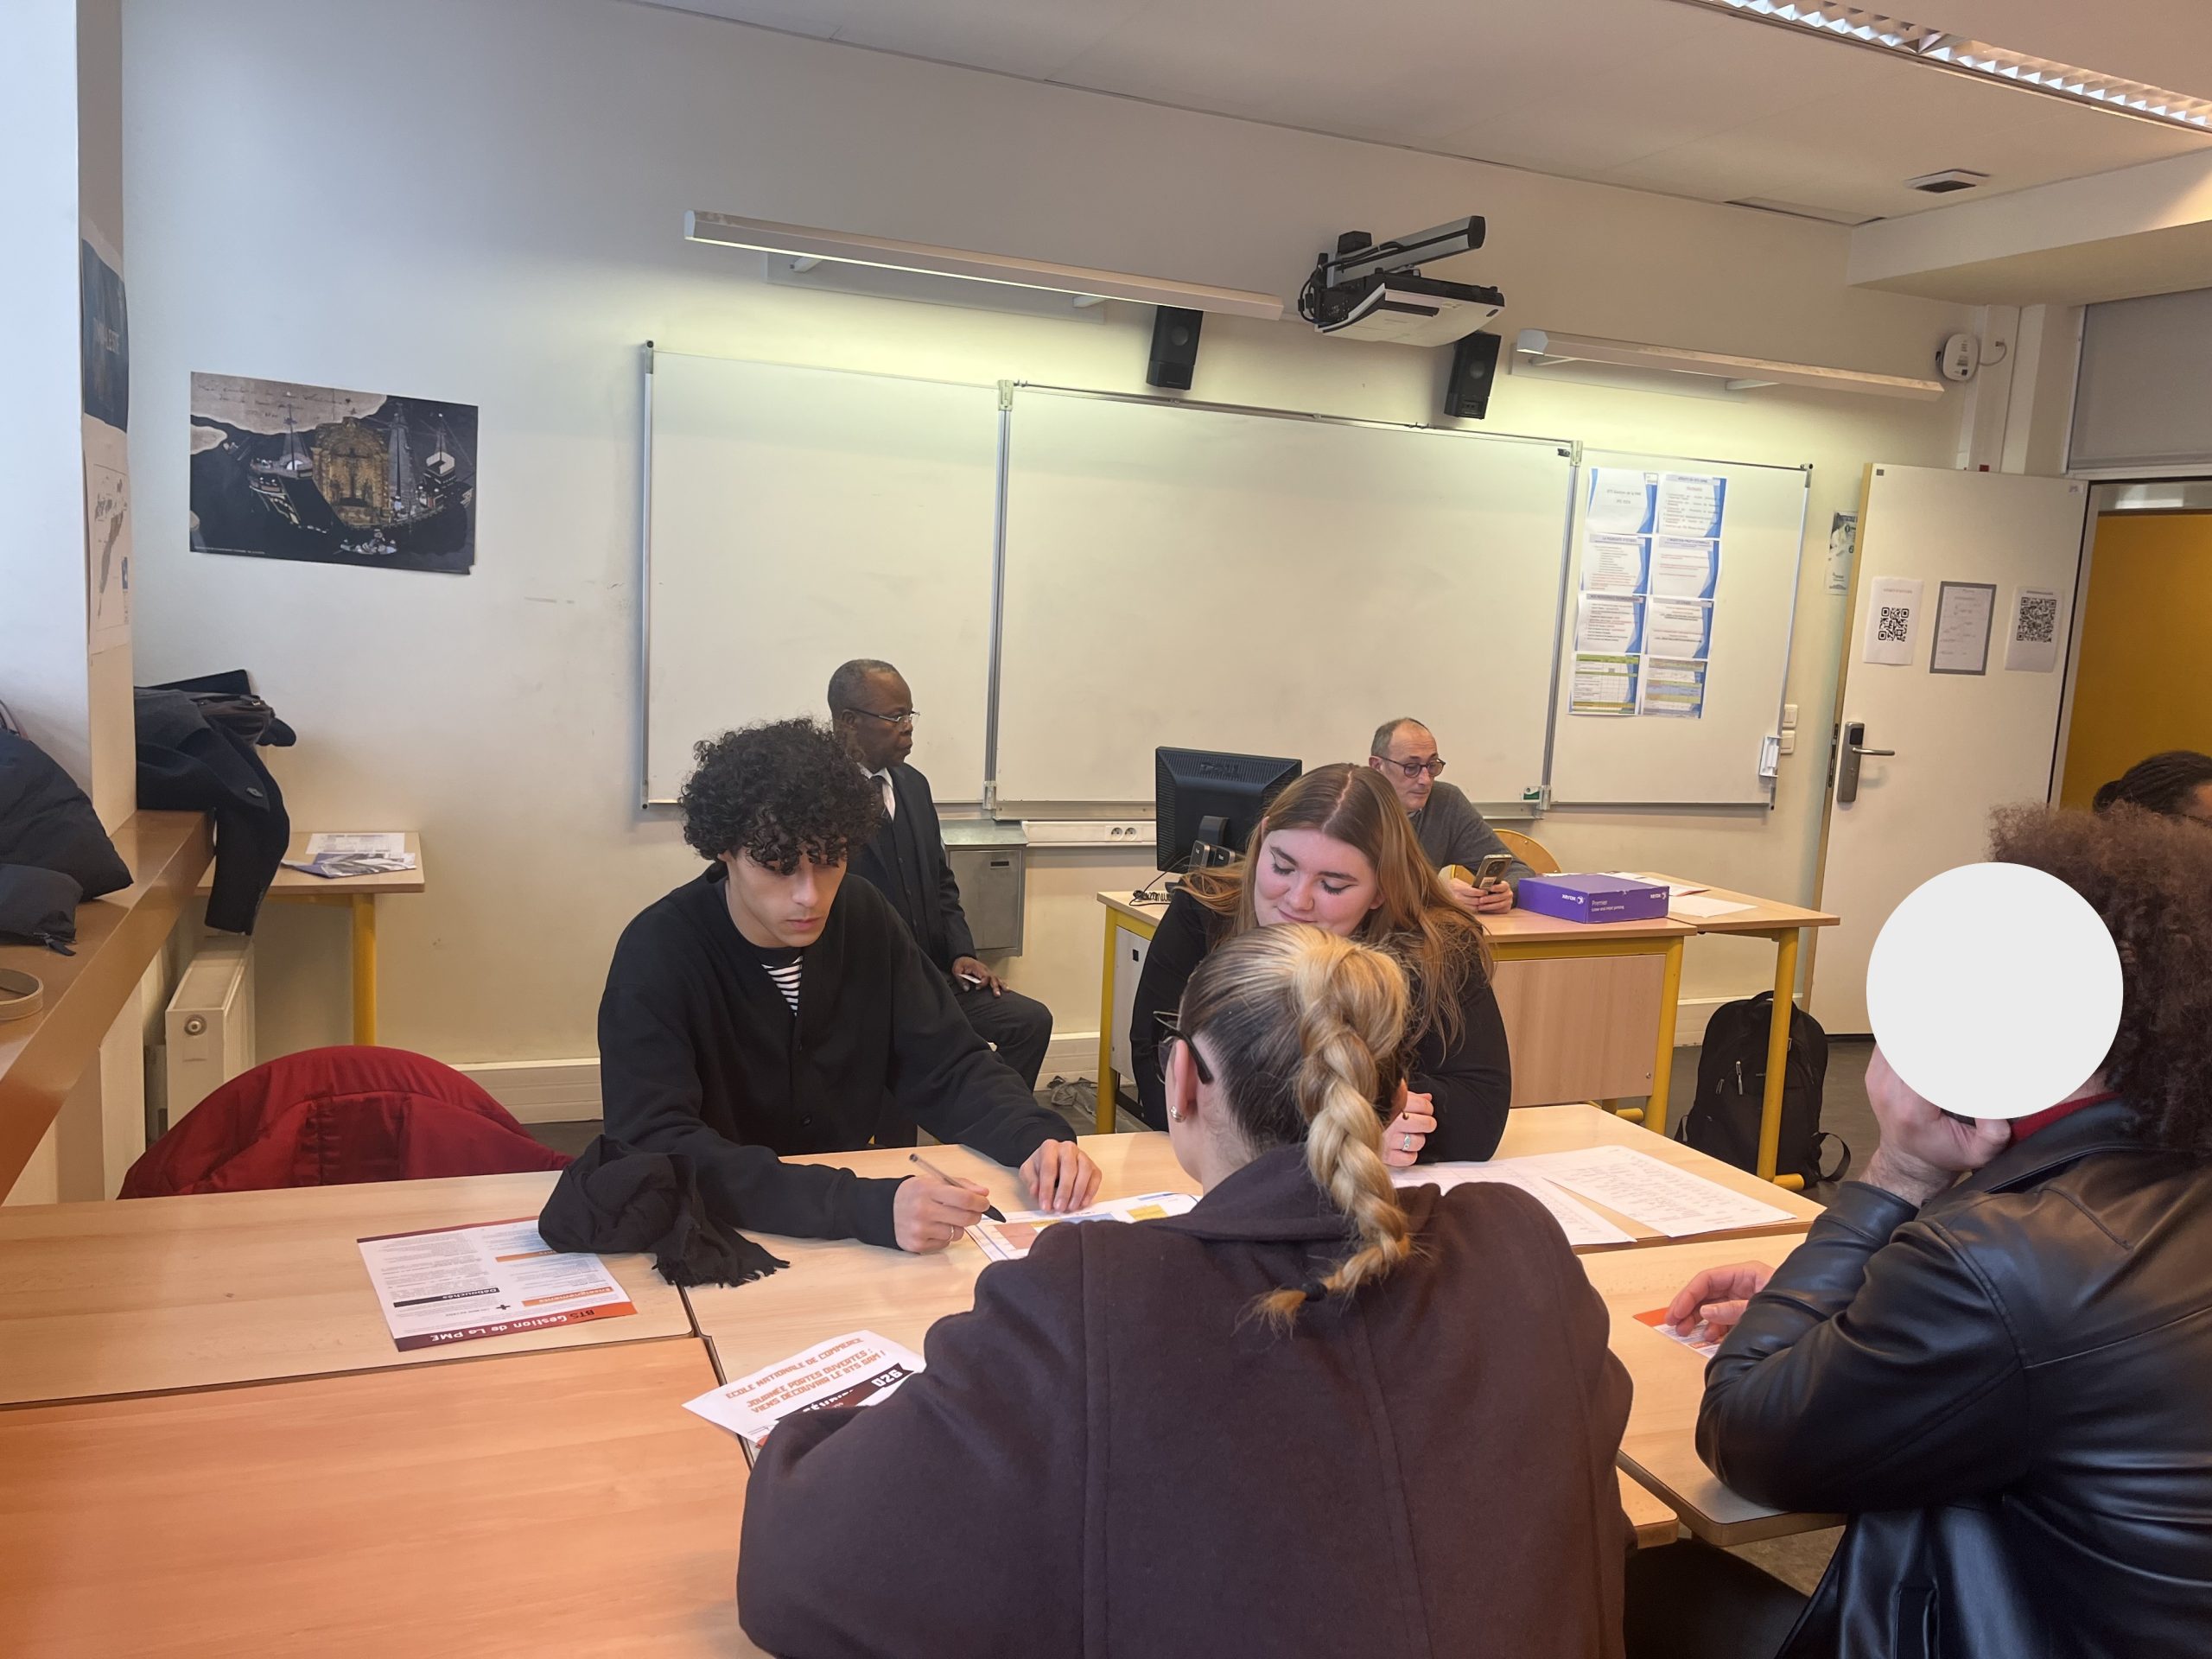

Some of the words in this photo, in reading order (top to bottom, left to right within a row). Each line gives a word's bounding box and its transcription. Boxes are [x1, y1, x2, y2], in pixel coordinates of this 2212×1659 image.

[1561, 893, 1576, 902] xerox
[442, 1287, 497, 1300] Débouchés
[569, 1309, 594, 1319] BTS
[514, 1315, 568, 1329] Gestion
[430, 1332, 464, 1342] PME
[756, 1362, 805, 1387] NATIONALE
[805, 1357, 818, 1365] DE
[818, 1338, 864, 1360] COMMERCE
[787, 1370, 823, 1389] PORTES
[823, 1350, 868, 1374] OUVERTES
[751, 1397, 780, 1413] VIENS
[830, 1371, 842, 1380] LE
[842, 1363, 861, 1374] BTS
[861, 1352, 881, 1365] SAM
